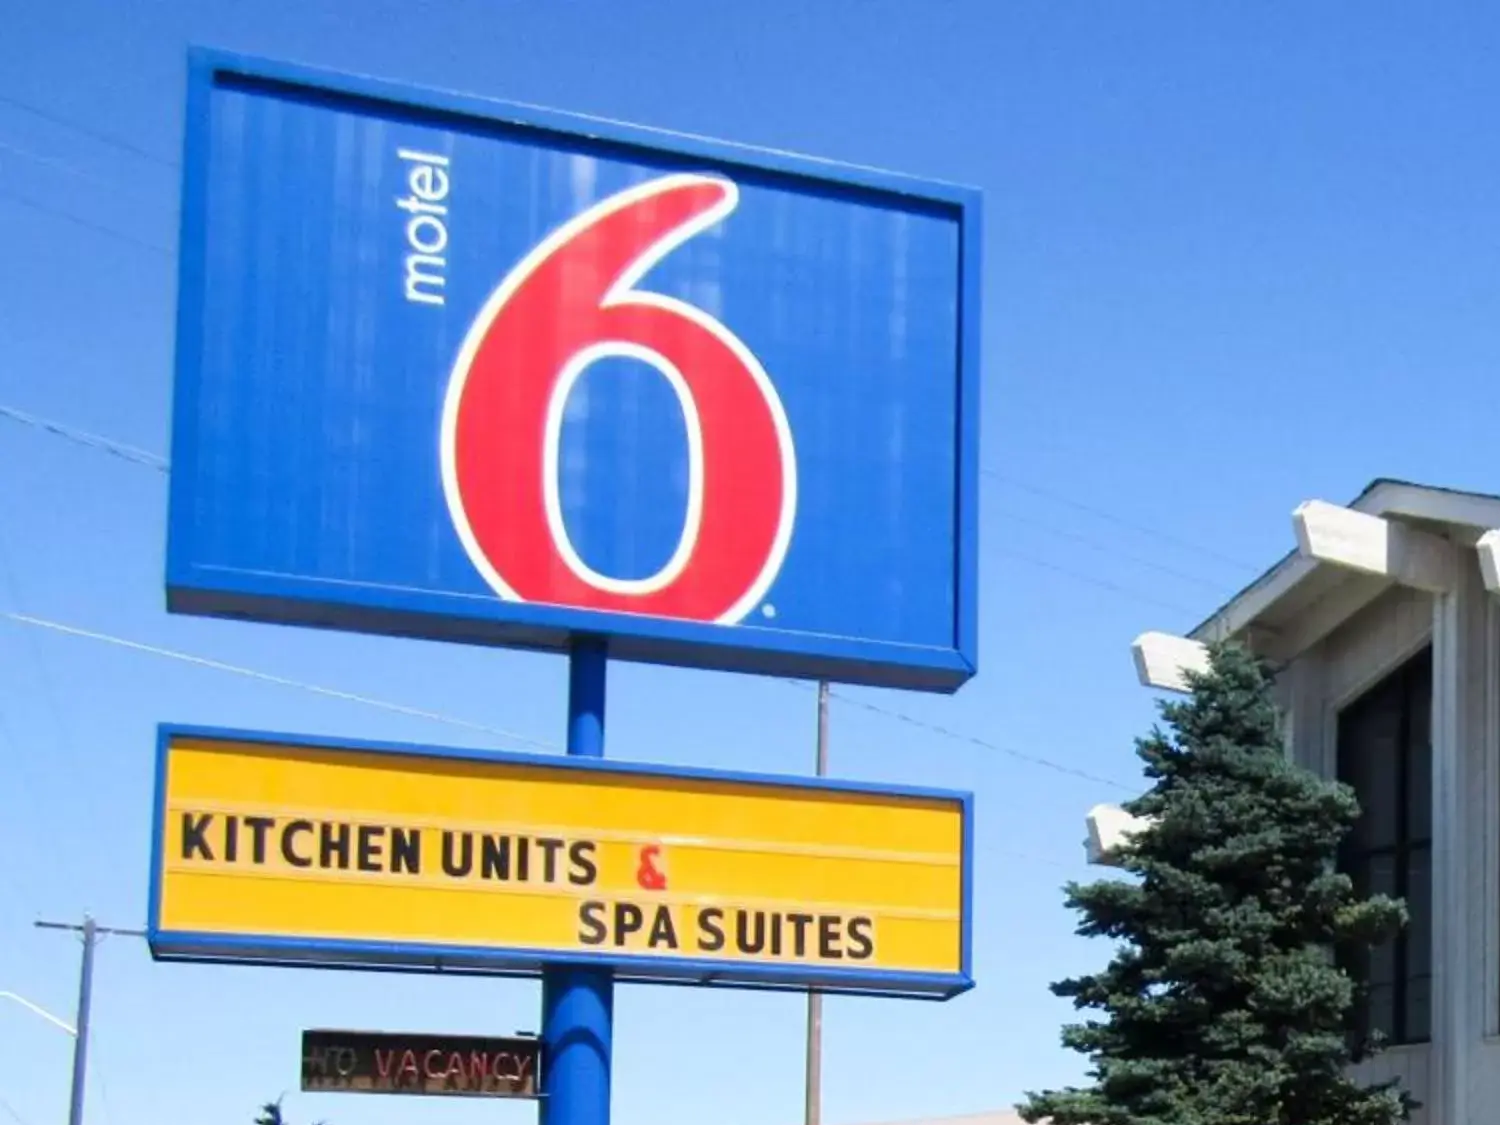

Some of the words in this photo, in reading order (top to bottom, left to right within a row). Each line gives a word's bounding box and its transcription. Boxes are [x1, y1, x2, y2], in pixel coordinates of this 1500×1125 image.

[397, 148, 451, 306] motel
[440, 172, 798, 627] 6
[181, 812, 422, 875] KITCHEN
[440, 829, 599, 886] UNITS
[636, 841, 667, 891] &
[577, 899, 679, 950] SPA
[697, 905, 874, 960] SUITES
[374, 1049, 532, 1081] VACANCY
